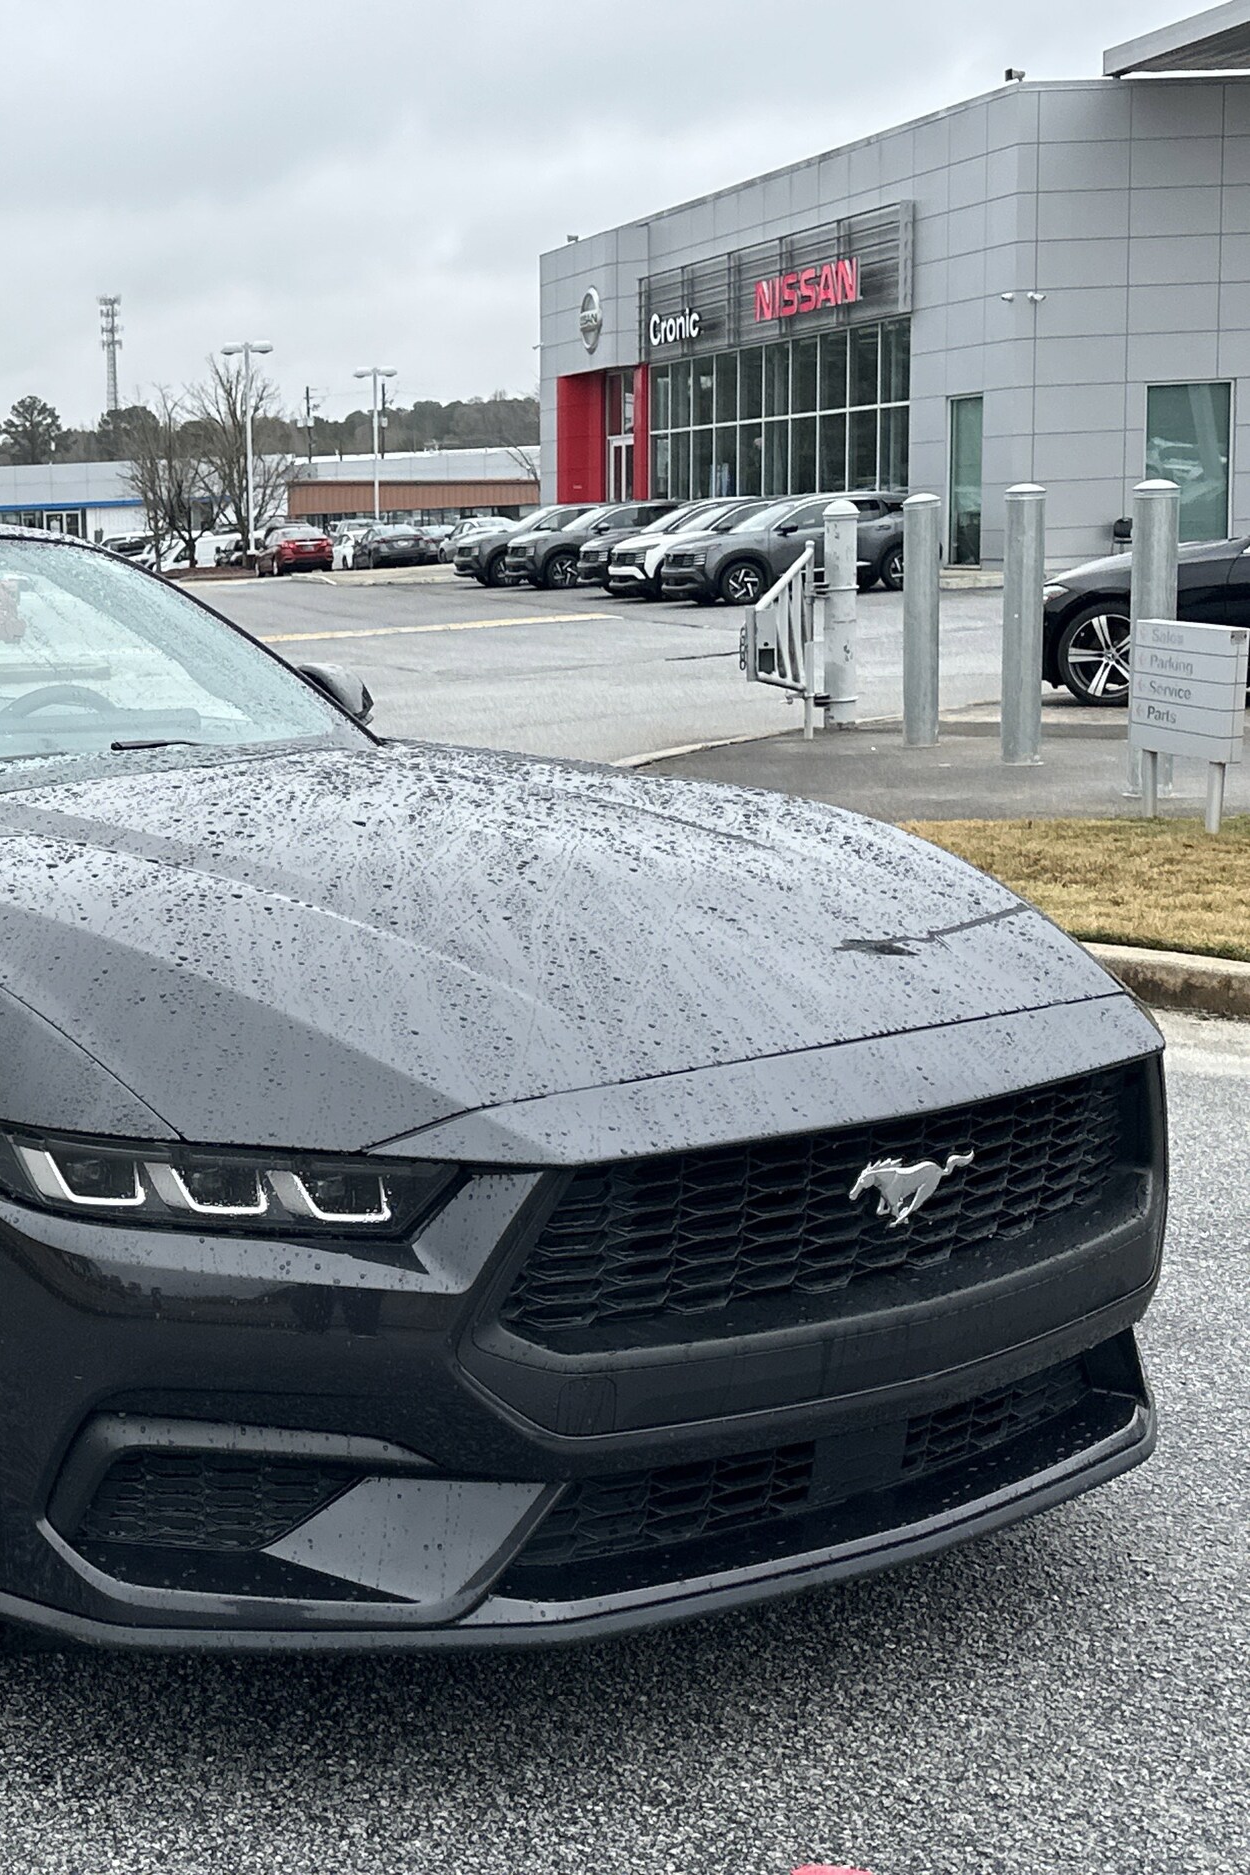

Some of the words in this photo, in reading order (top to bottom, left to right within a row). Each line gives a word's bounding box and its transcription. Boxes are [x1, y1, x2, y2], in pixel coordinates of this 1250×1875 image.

[754, 256, 858, 322] NISSAN
[650, 307, 700, 346] Cronic
[1151, 627, 1184, 644] Sales
[1149, 653, 1194, 677] Parking
[1149, 679, 1192, 700] Service
[1146, 704, 1178, 724] Parts
